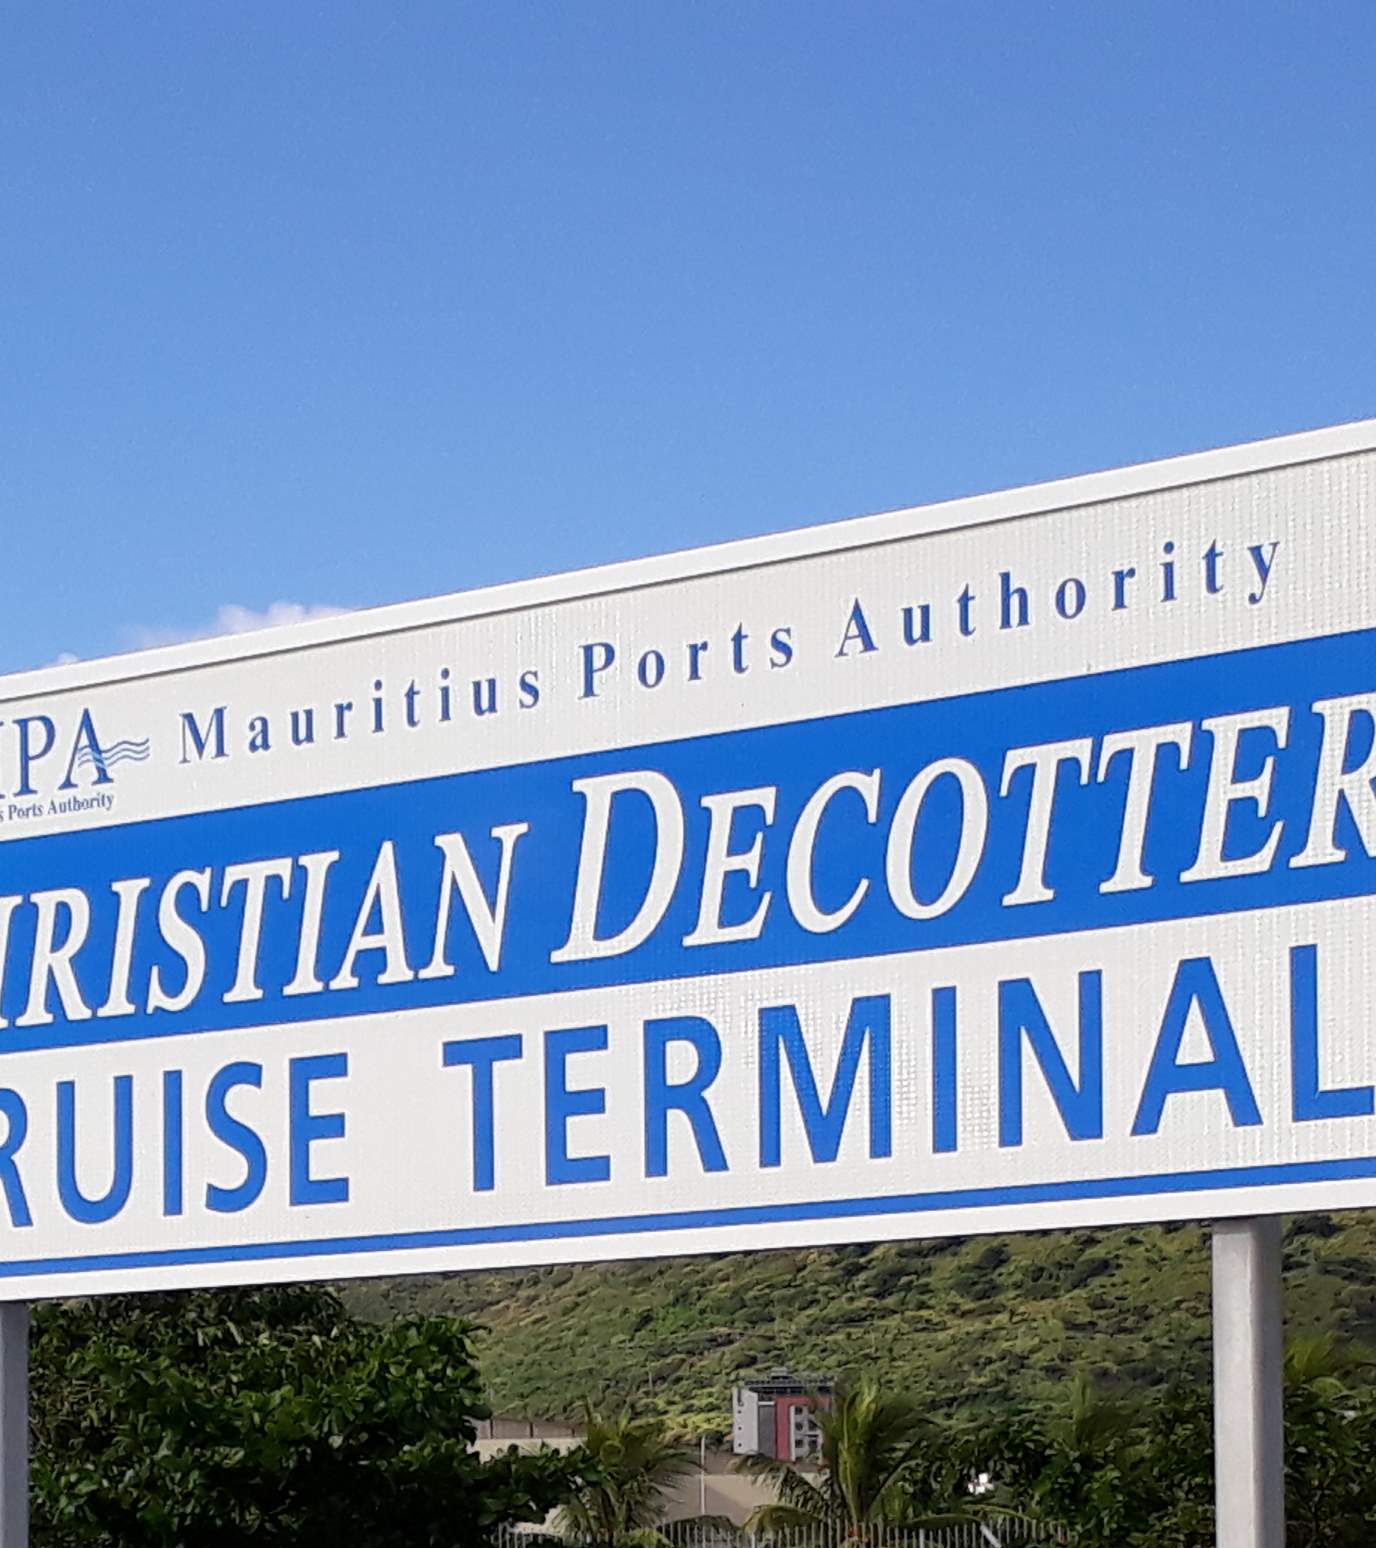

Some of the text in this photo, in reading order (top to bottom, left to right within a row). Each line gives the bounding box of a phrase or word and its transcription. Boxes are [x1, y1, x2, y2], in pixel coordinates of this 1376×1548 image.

[179, 540, 1281, 764] Mauritius Ports Authority
[8, 803, 44, 821] Ports
[47, 792, 115, 816] Authority
[442, 943, 1376, 1192] TERMINAL
